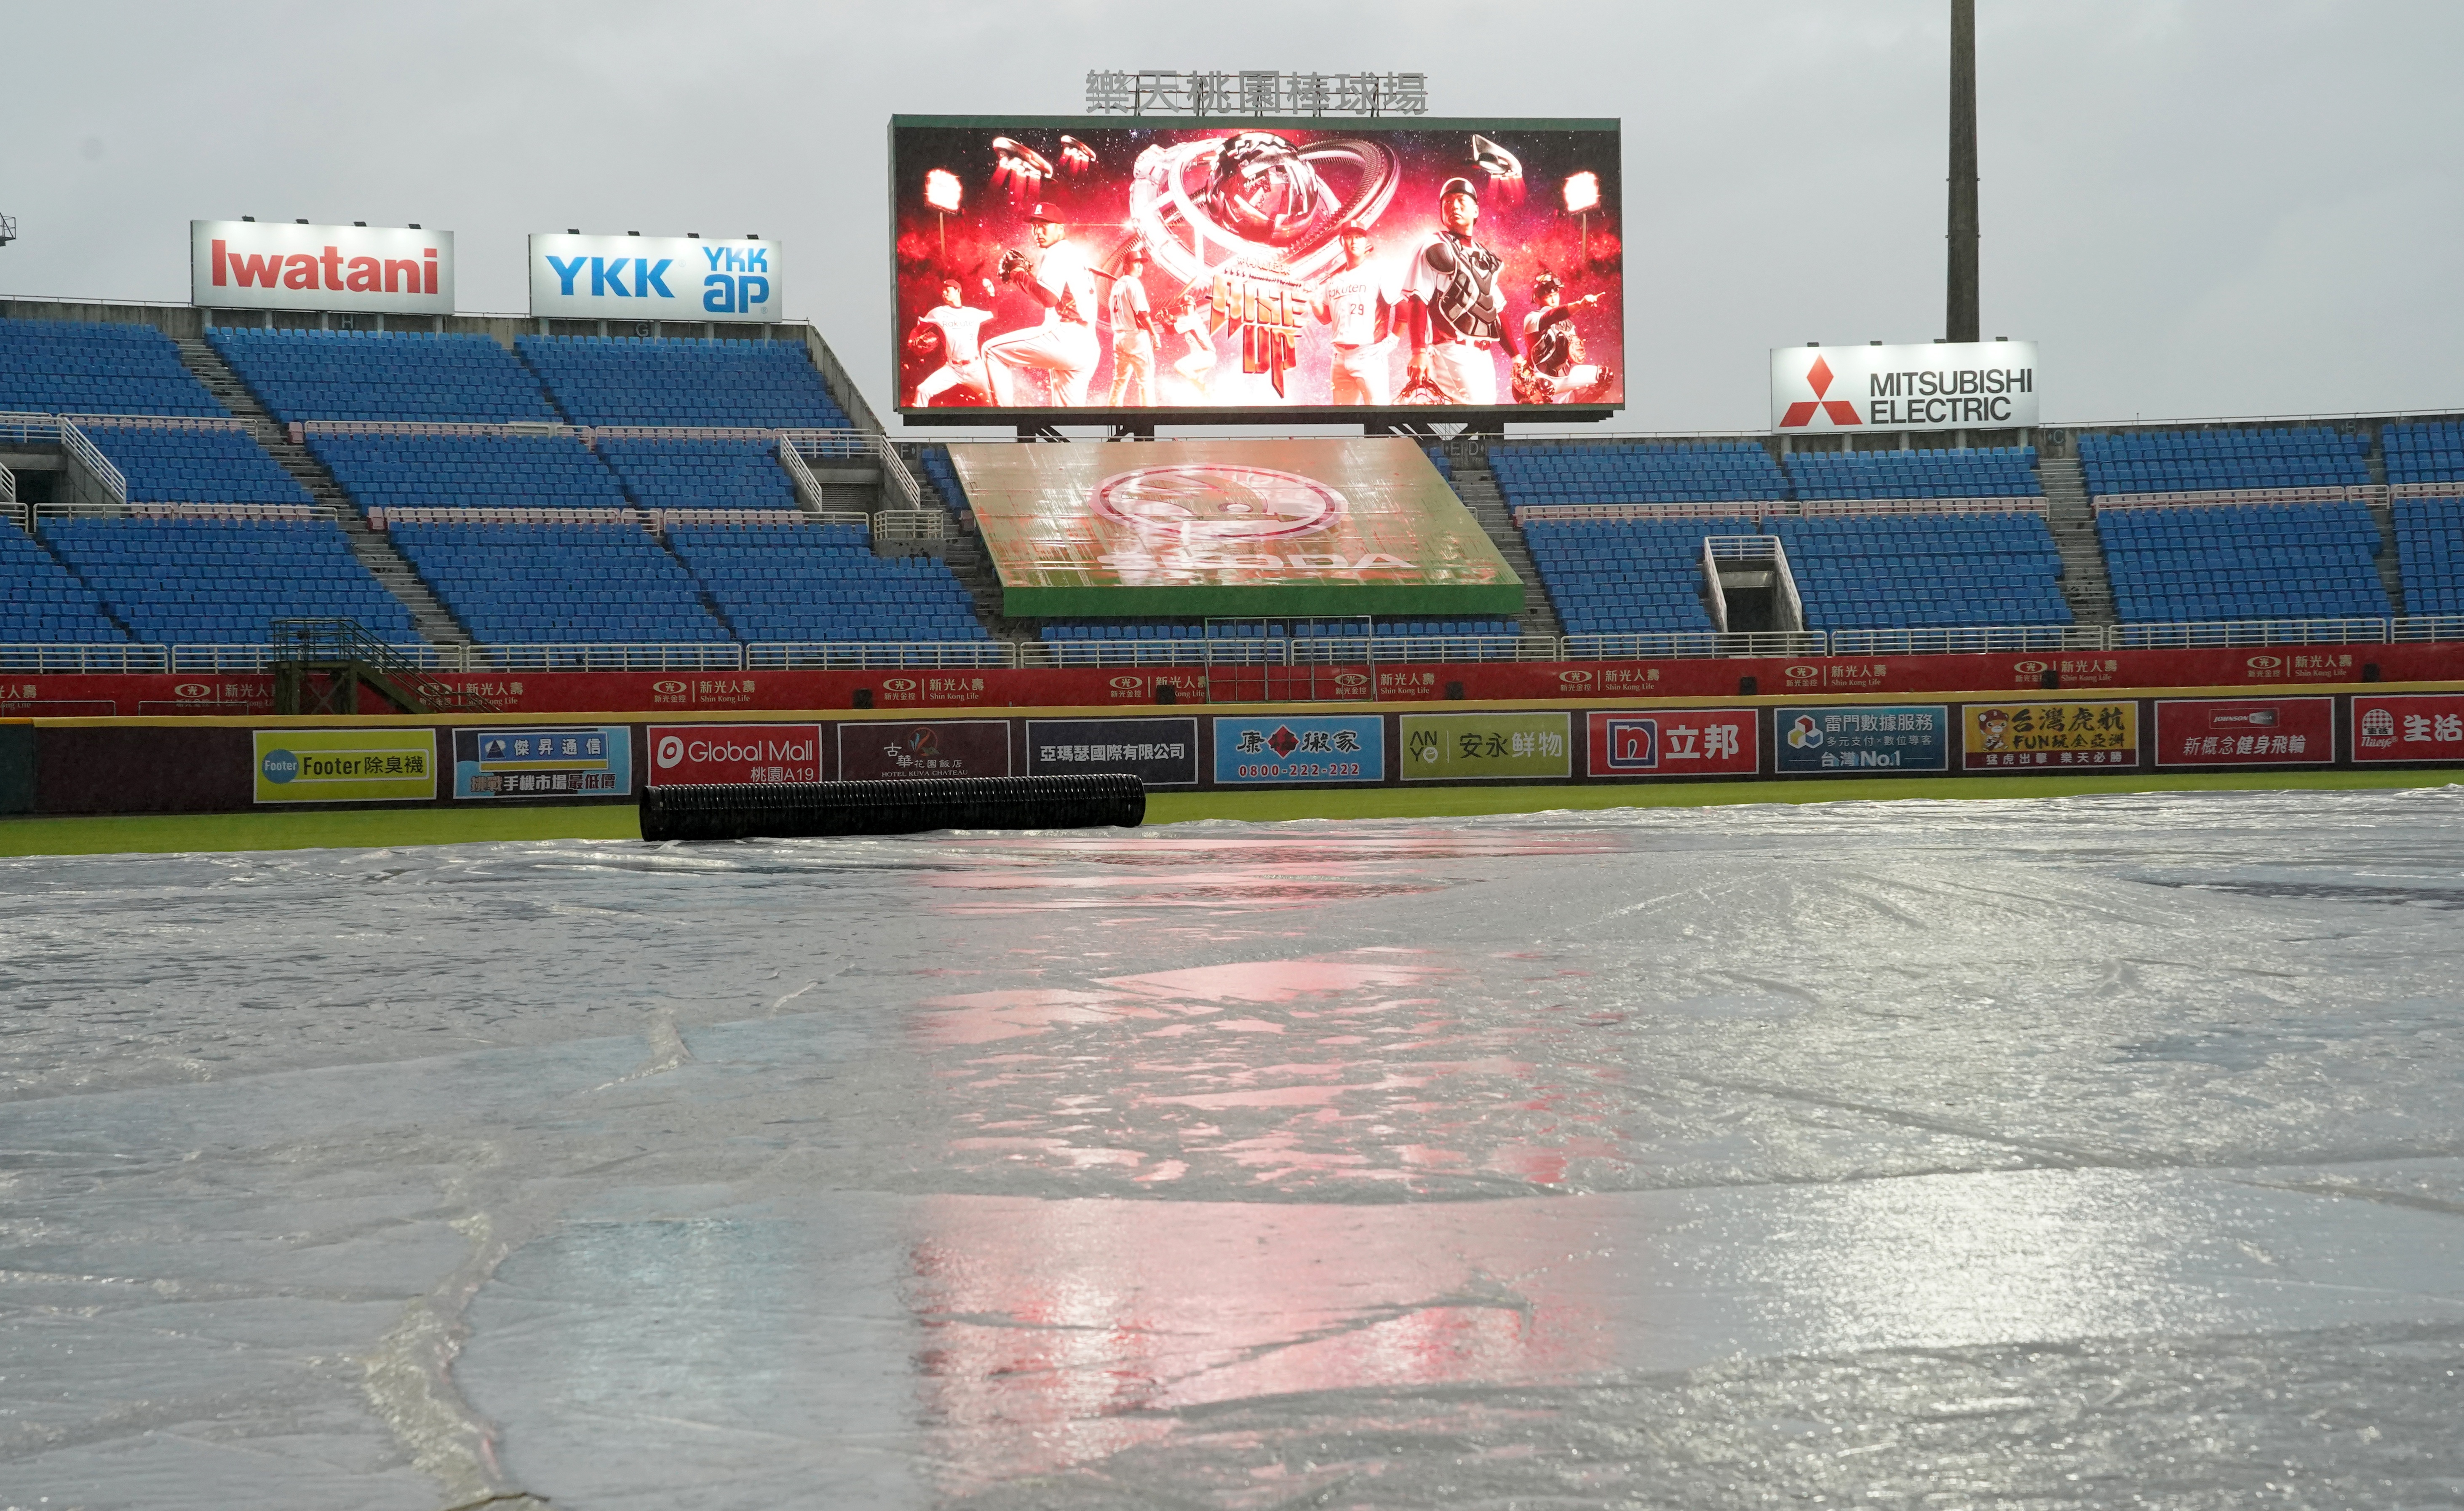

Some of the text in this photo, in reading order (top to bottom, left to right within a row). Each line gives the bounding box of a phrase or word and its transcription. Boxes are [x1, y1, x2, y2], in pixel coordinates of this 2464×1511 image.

[1086, 70, 1428, 115] 樂天桃園棒球場
[212, 239, 438, 294] Iwatani
[702, 246, 768, 273] YKK
[545, 255, 676, 298] YKK
[703, 274, 770, 313] ap
[1350, 303, 1364, 316] 29
[1871, 369, 2032, 396] MITSUBISHI
[1871, 396, 2011, 424] ELECTRIC
[2061, 660, 2117, 673] 新光人壽
[2295, 654, 2352, 668] 新光人壽
[1605, 669, 1660, 682] 新光人壽
[1831, 665, 1887, 677] 新光人壽
[929, 678, 984, 691] 新光人壽
[1380, 672, 1435, 686] 新光人壽
[1849, 679, 1866, 687] Kong
[225, 684, 275, 697] 新光人
[466, 682, 524, 695] 新光人壽
[700, 680, 755, 694] 新光人壽
[1398, 687, 1415, 695] Kong
[1623, 684, 1640, 692] Kong
[947, 693, 965, 701] Kong
[1825, 714, 1933, 733] 雷門數據服務
[2012, 707, 2125, 733] 台灣虎航
[514, 738, 602, 756] 傑昇通信
[1459, 731, 1562, 758] 安永鮮物
[1666, 724, 1739, 760] 立邦
[2183, 734, 2306, 756] 新概念健身飛輪
[688, 740, 812, 762] Global Mall
[1040, 743, 1185, 762] 亞瑪瑟國際有限公司
[1986, 751, 2122, 765] 猛虎出擊 樂天必勝
[264, 760, 298, 772] Footer
[1239, 763, 1360, 777] 0800-222-222
[751, 767, 814, 782] 桃園A19
